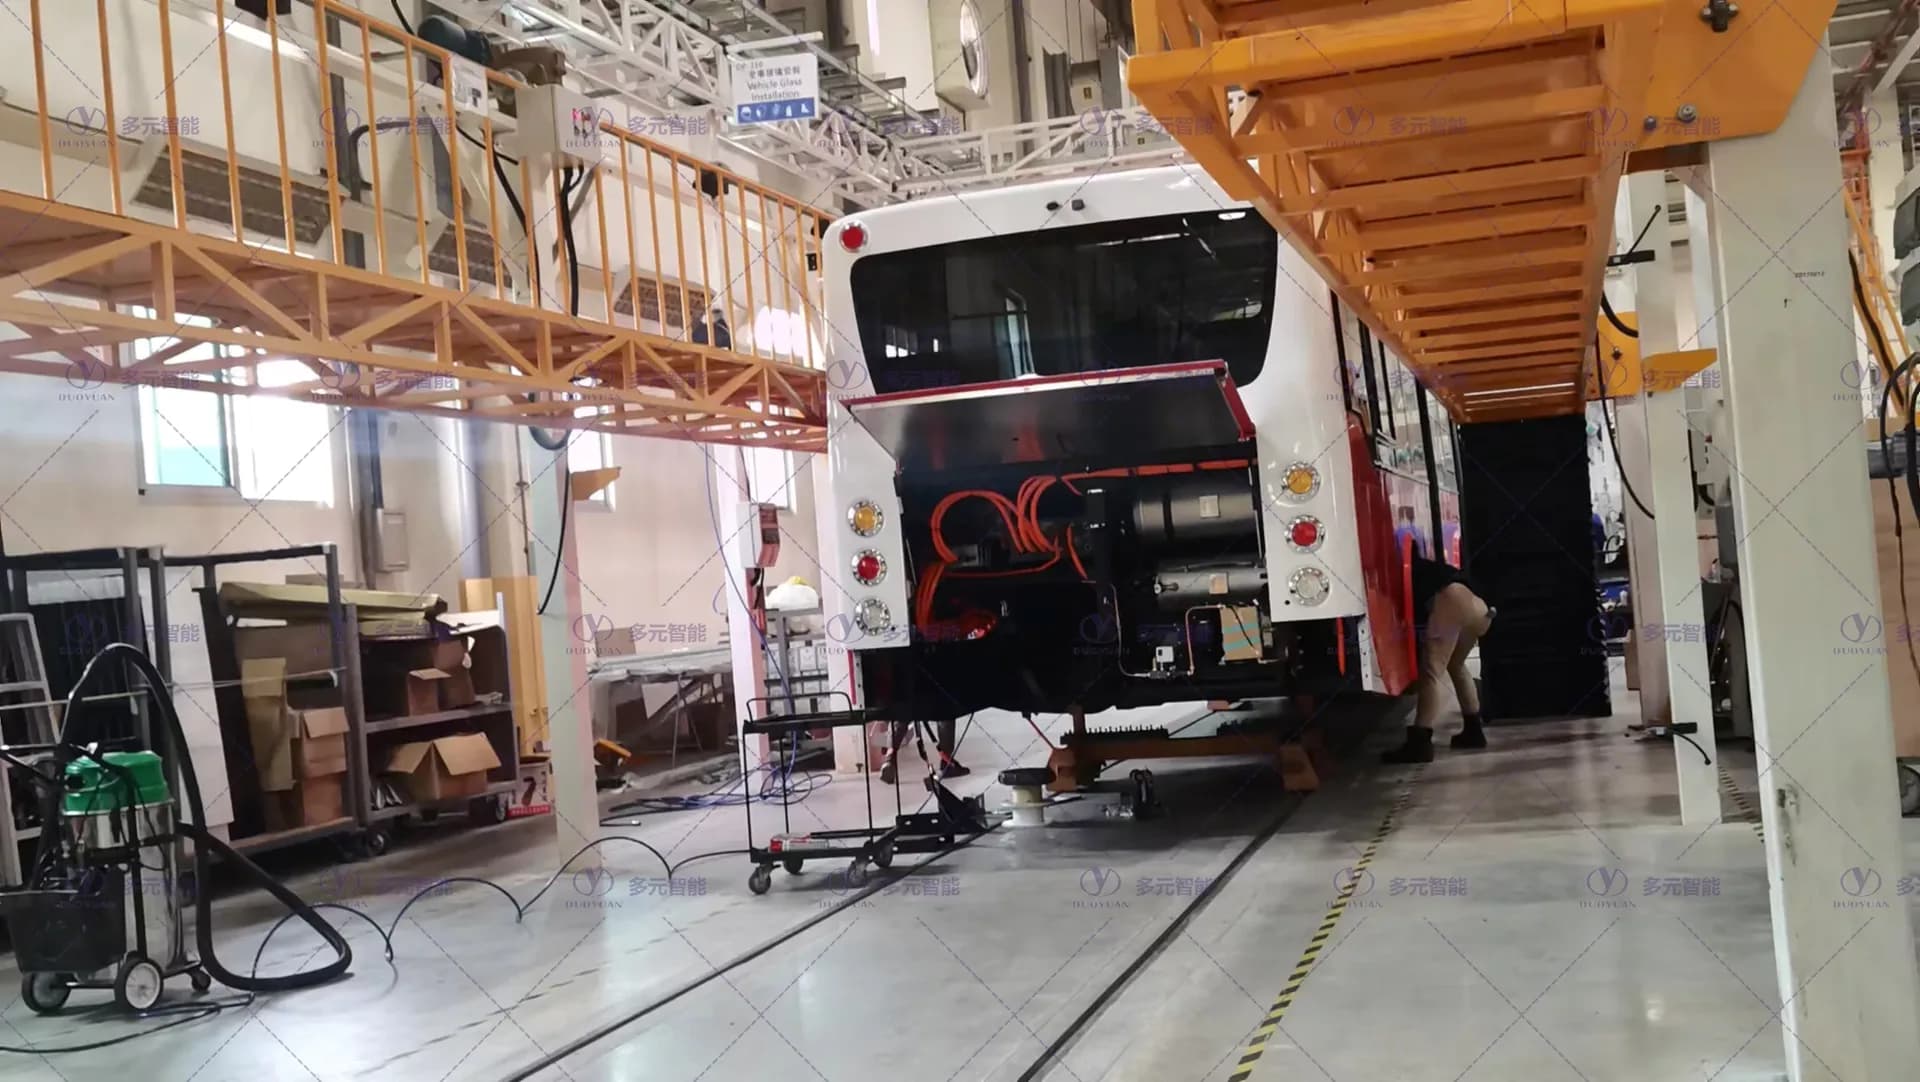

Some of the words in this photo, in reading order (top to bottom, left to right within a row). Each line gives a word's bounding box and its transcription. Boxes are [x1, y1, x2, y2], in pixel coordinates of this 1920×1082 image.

[747, 80, 779, 91] Vehicle
[780, 78, 802, 88] Glass
[751, 90, 800, 101] Installation
